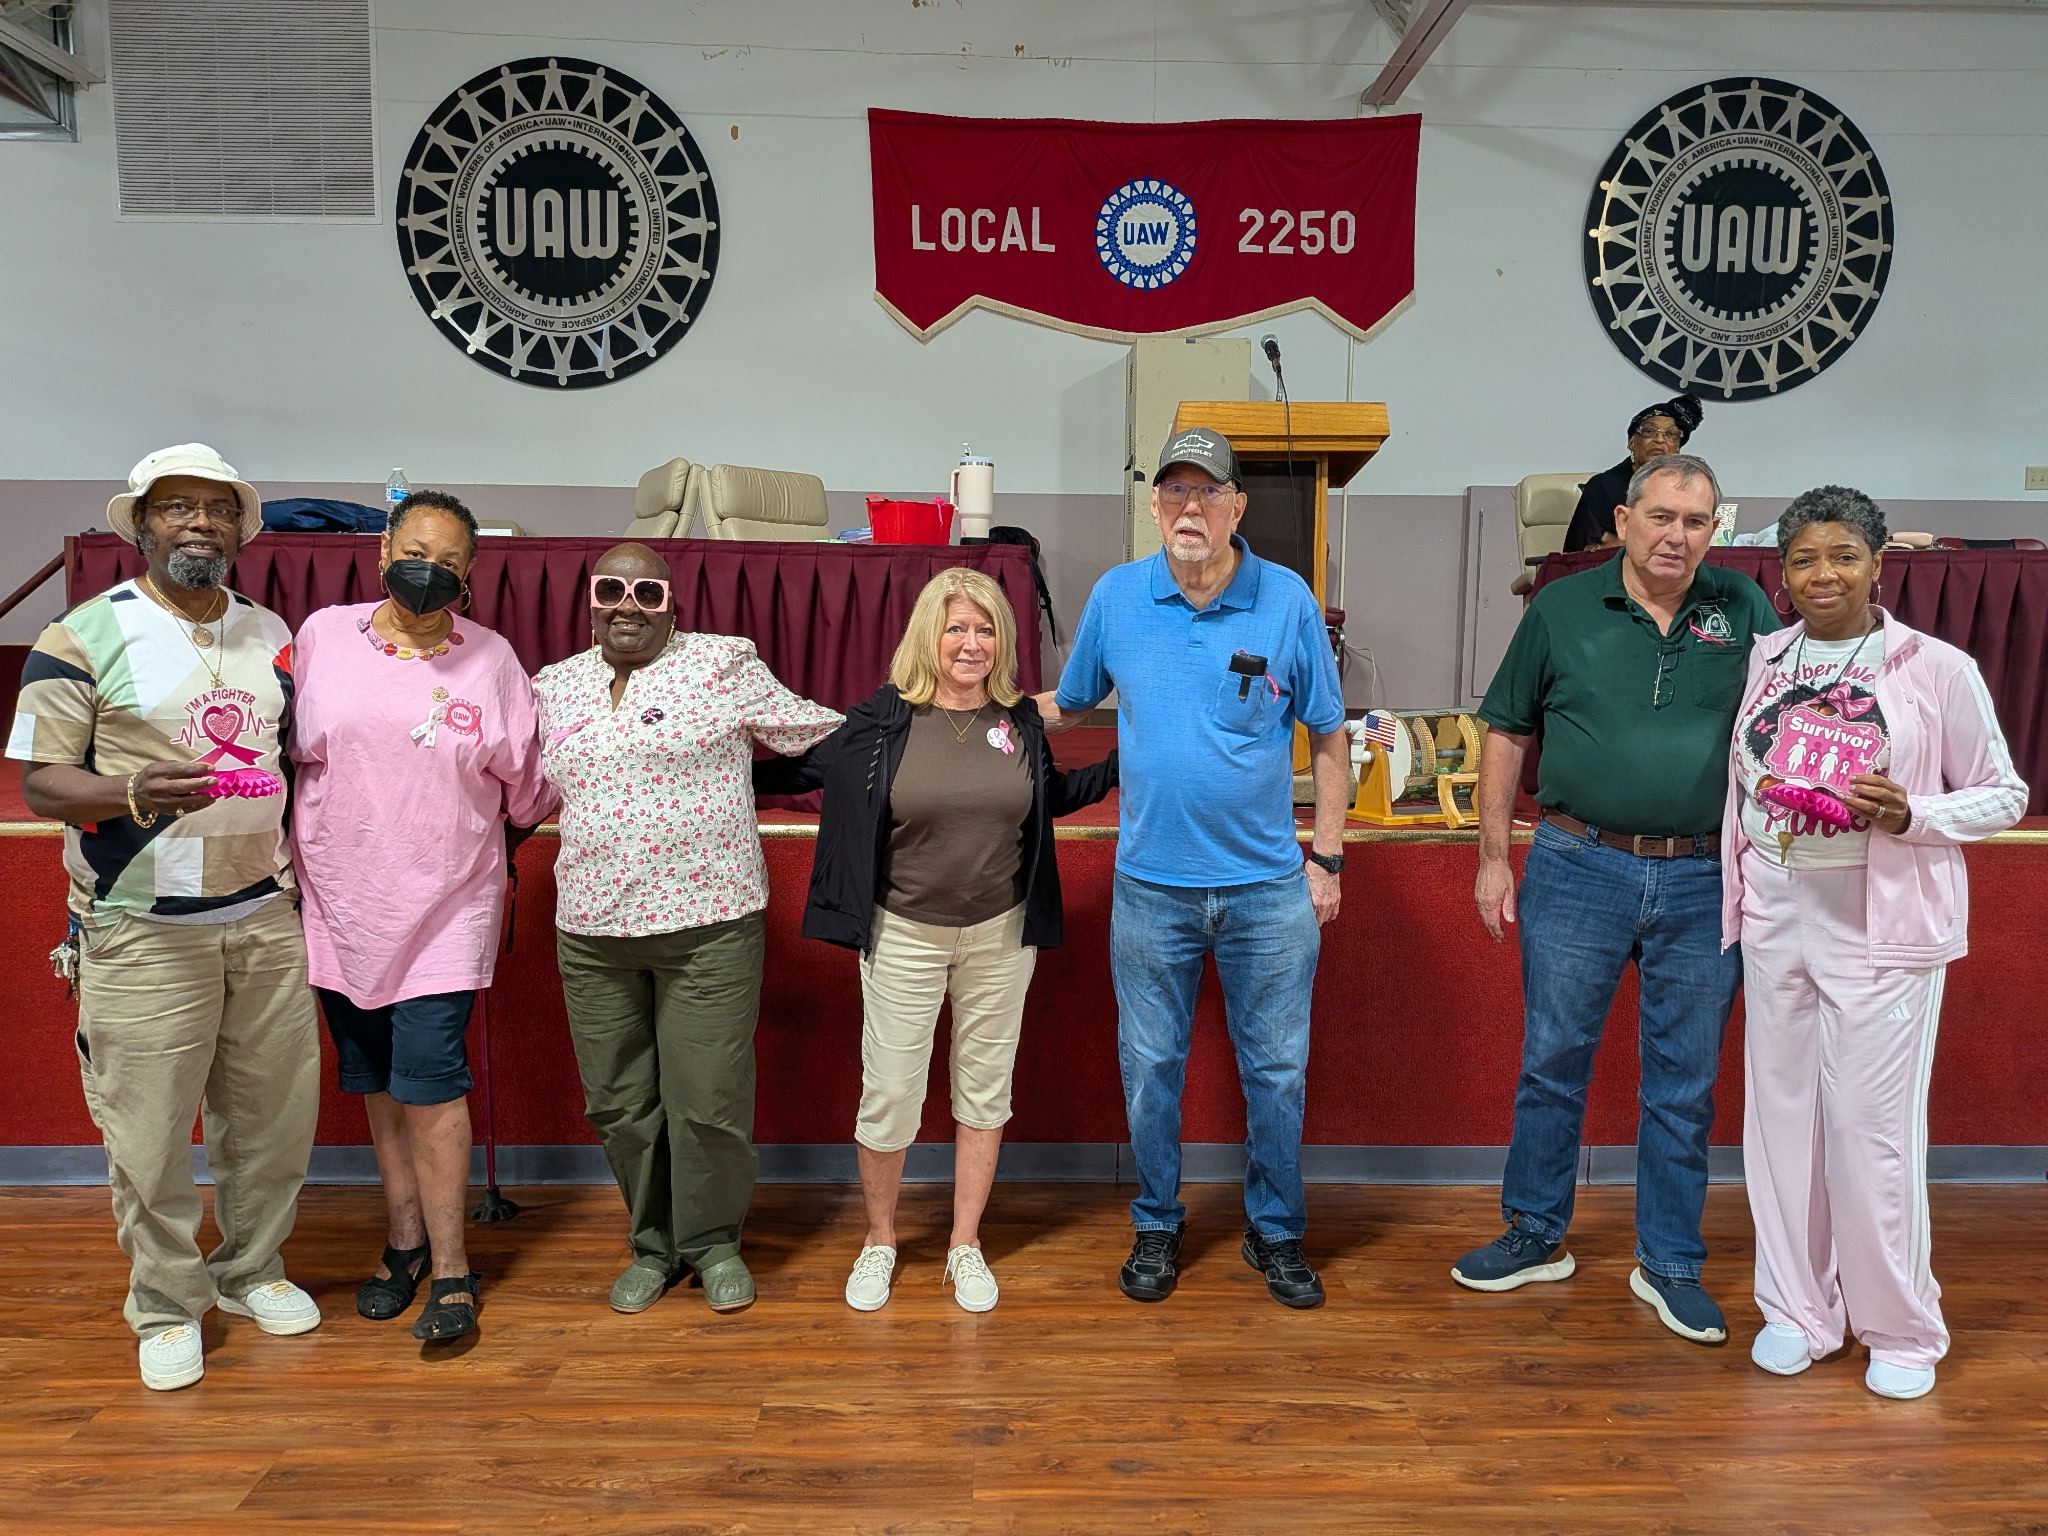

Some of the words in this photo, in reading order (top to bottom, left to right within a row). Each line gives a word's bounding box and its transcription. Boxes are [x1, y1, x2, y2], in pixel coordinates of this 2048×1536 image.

[498, 119, 541, 142] AMERICA
[545, 118, 567, 126] UAW
[483, 140, 496, 153] OF
[573, 120, 639, 169] INTERNATIONAL
[1691, 138, 1733, 161] AMERICA
[1737, 136, 1759, 145] UAW
[457, 153, 484, 199] WORKERS
[1676, 158, 1689, 171] OF
[1764, 139, 1824, 187] INTERNATIONAL
[639, 171, 657, 203] UNION
[1647, 171, 1677, 215] WORKERS
[1822, 189, 1838, 220] UNION
[455, 203, 472, 263] IMPLEMENT
[495, 187, 619, 260] UAW
[651, 208, 661, 245] UNITED
[912, 205, 1056, 252] LOCAL
[1238, 209, 1356, 254] 2250
[1123, 221, 1170, 246] UAW
[1682, 203, 1802, 274] UAW
[1642, 221, 1656, 278] IMPLEMENT
[1831, 224, 1841, 261] UNITED
[471, 267, 528, 321] AGRICULTURAL
[620, 251, 656, 307] AUTOMOBILE
[1793, 267, 1833, 322] AUTOMOBILE
[534, 317, 555, 328] AND
[561, 306, 616, 329] AEROSPACE
[1653, 281, 1705, 334] AGRICULTURAL
[1711, 332, 1730, 342] AND
[1735, 320, 1789, 343] AEROSPACE
[1171, 448, 1213, 459] CHEVROLET
[1764, 663, 1838, 697] October
[1844, 661, 1876, 682] We
[185, 698, 203, 714] I'M
[202, 694, 211, 704] A
[211, 689, 256, 706] FIGHTER
[453, 711, 469, 722] UAW
[1789, 716, 1873, 750] Survivor
